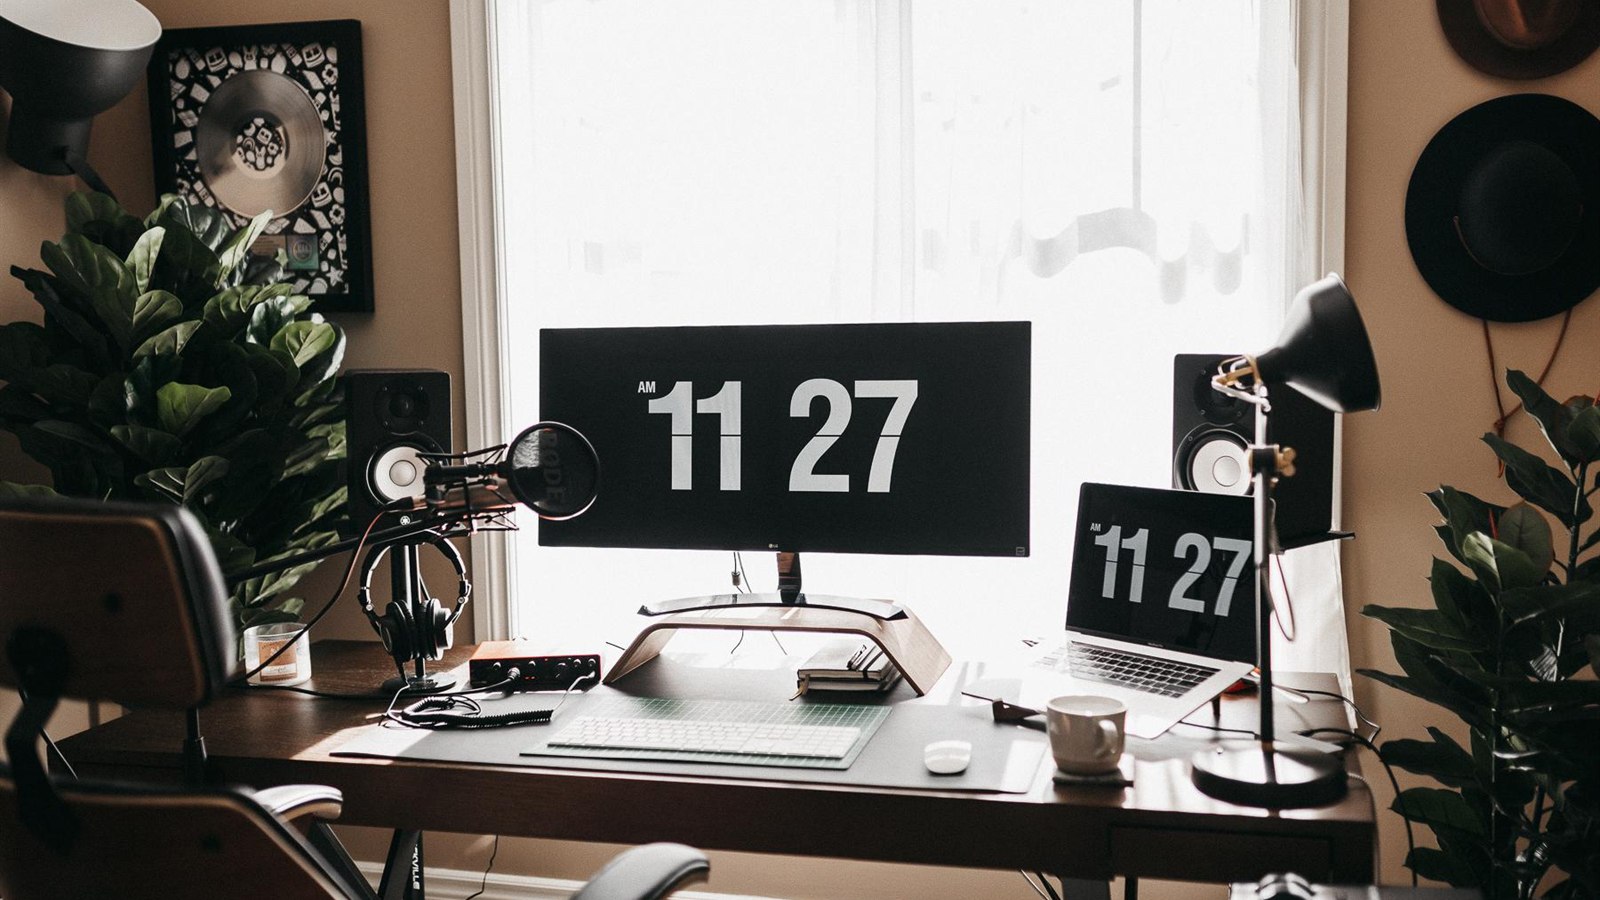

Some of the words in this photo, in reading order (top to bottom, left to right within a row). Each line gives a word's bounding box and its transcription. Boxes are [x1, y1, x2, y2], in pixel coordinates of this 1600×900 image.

[637, 380, 656, 394] AM
[648, 380, 742, 491] 11
[788, 377, 919, 493] 27
[1089, 522, 1102, 532] AM
[1094, 524, 1150, 604] 11
[1167, 532, 1253, 617] 27
